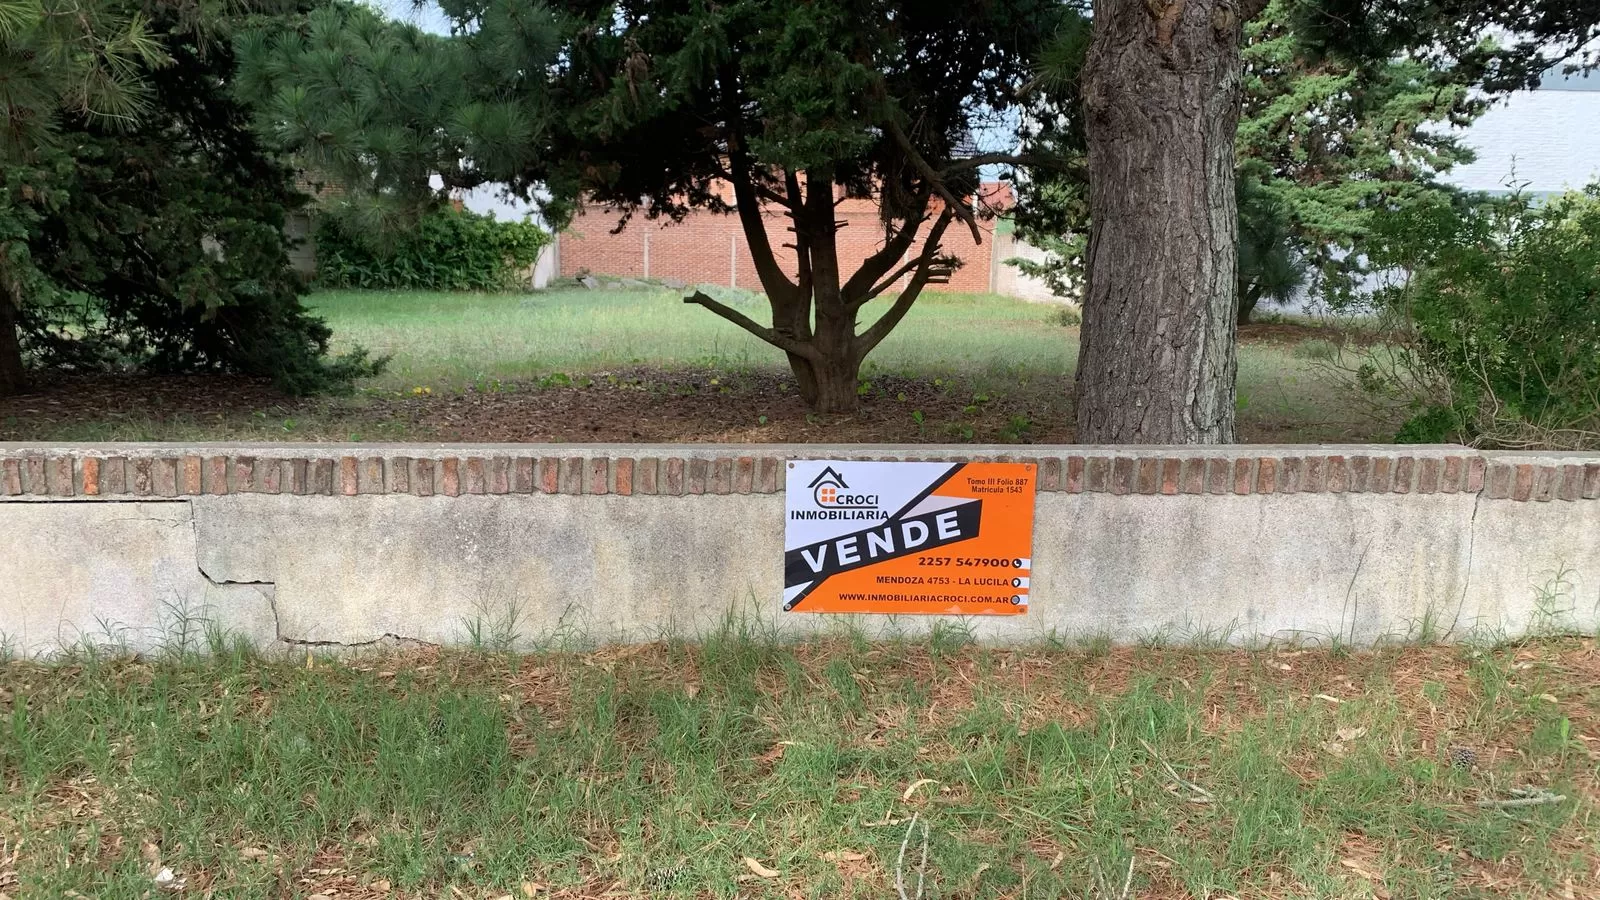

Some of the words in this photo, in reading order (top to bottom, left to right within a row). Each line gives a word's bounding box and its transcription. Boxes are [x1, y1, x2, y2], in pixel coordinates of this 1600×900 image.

[997, 478, 1014, 486] Folio
[1015, 478, 1028, 486] 887
[1006, 486, 1022, 494] 1543
[836, 495, 879, 505] CROCI
[791, 510, 889, 520] INMOBILIARIA
[800, 510, 961, 573] VENDE
[918, 557, 951, 566] 2257
[956, 558, 1010, 567] 547900
[876, 576, 925, 584] MENDOZA
[927, 577, 950, 585] 4753
[958, 577, 970, 585] LA
[974, 578, 1009, 586] LUCILA
[839, 593, 1009, 604] WWW.INMOBILIARIACROCI.COM.AR
